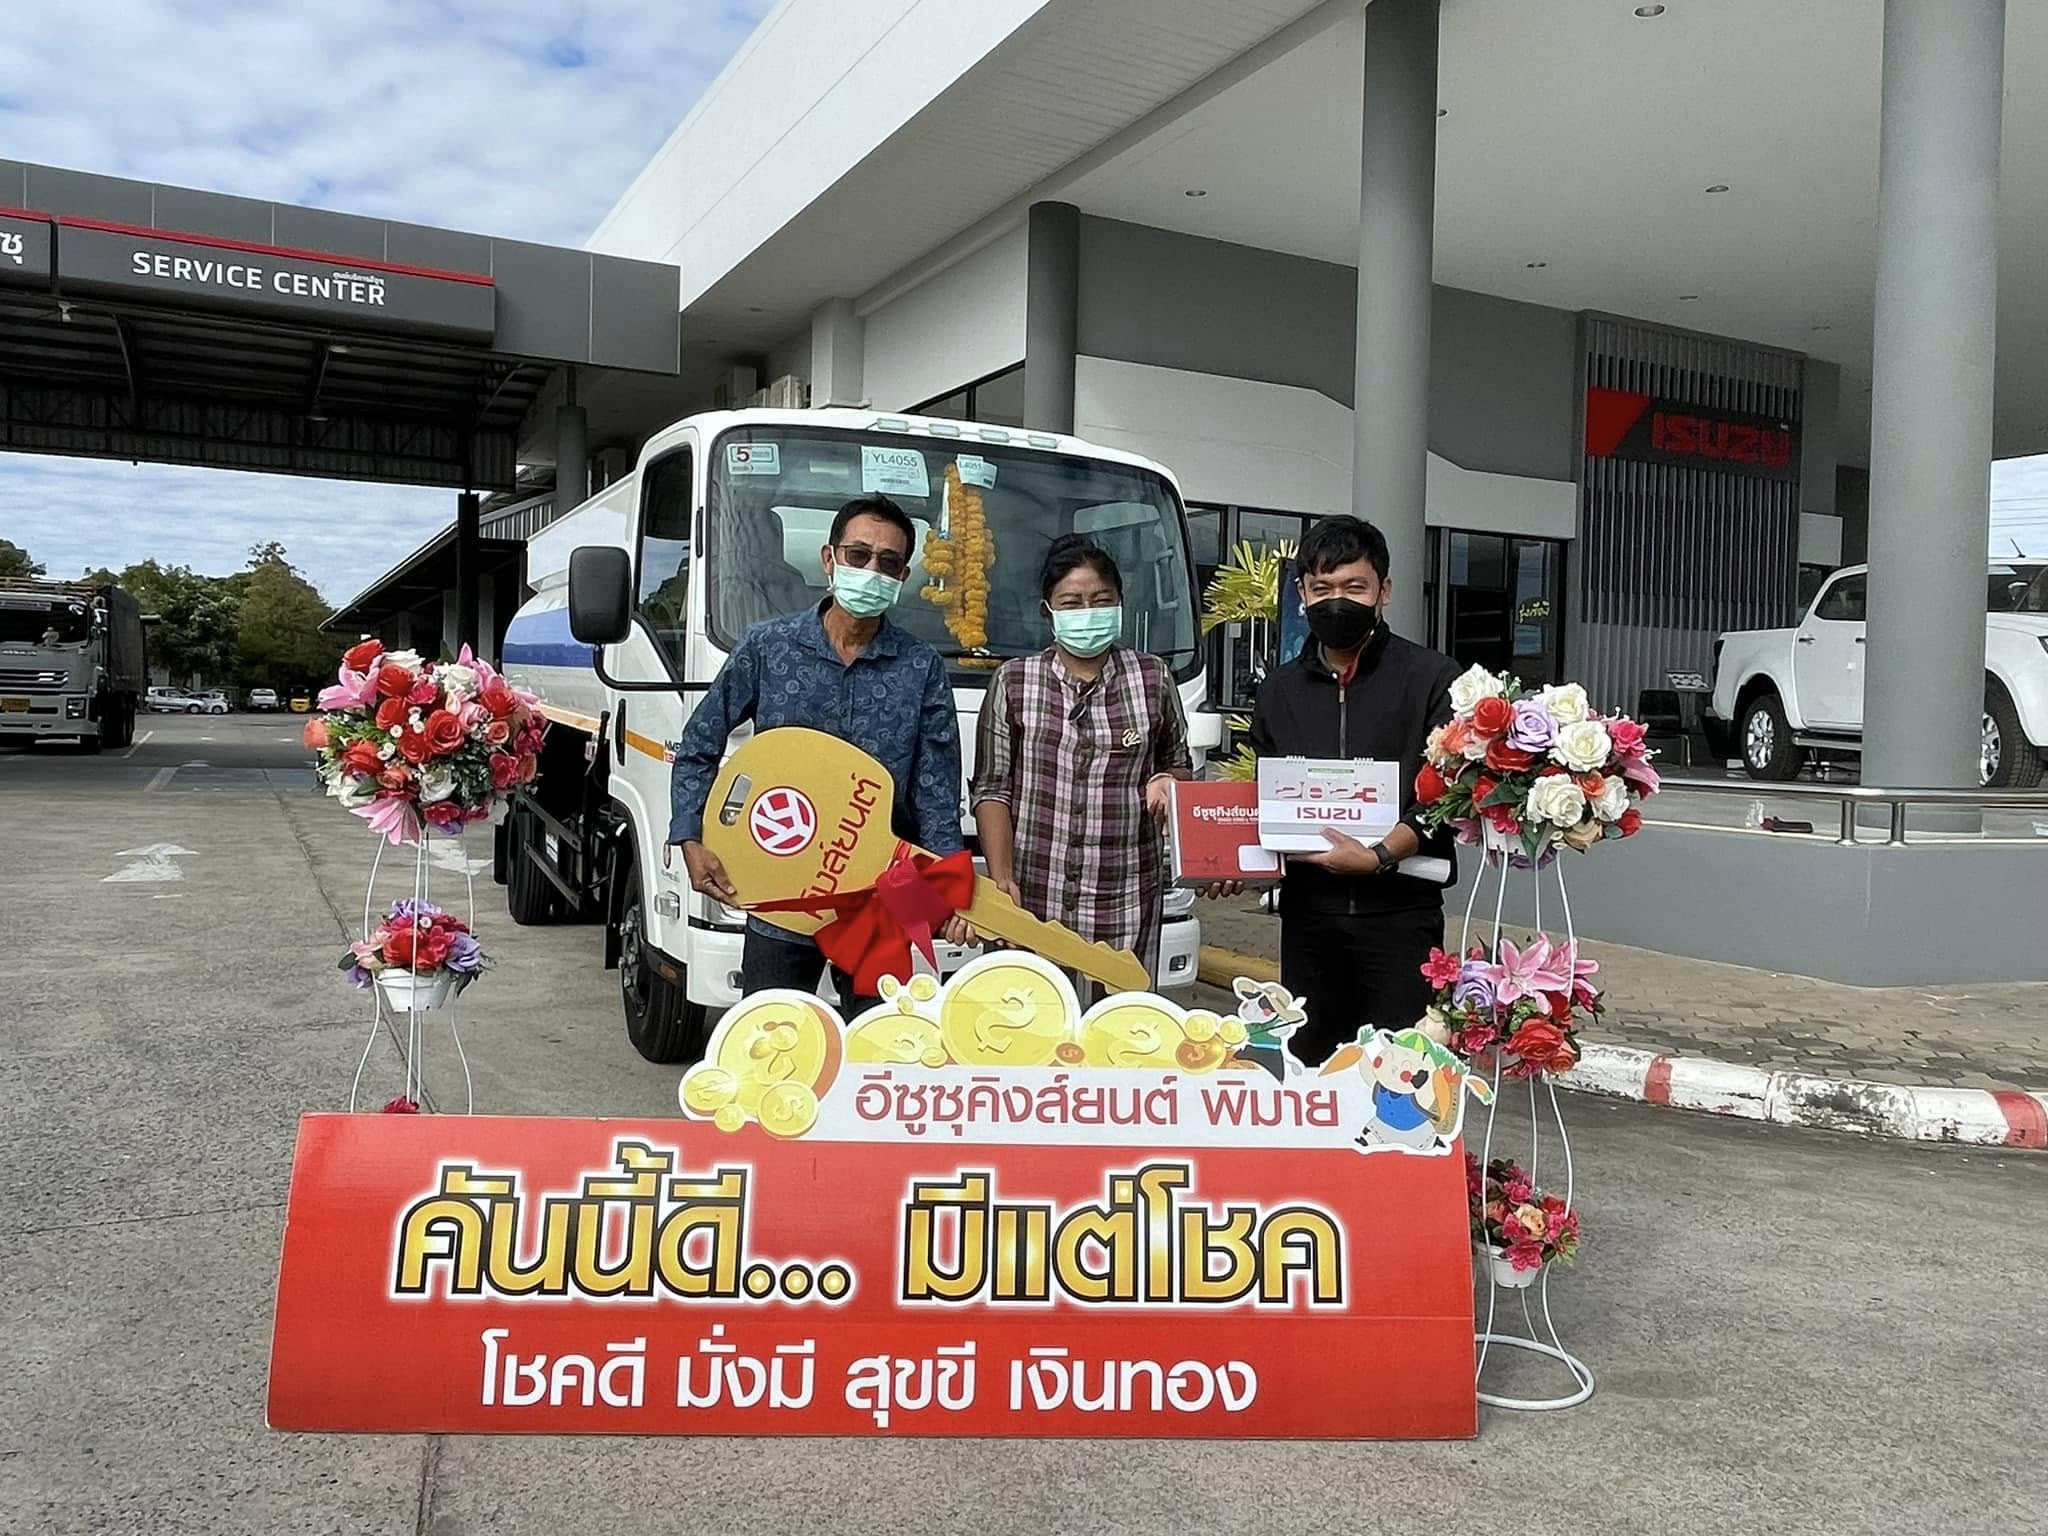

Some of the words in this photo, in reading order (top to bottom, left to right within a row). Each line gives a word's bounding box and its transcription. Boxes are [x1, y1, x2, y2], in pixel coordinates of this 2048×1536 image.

[132, 251, 263, 290] SERVICE
[273, 271, 385, 306] CENTER
[736, 446, 750, 463] 5
[872, 453, 918, 468] YL4055
[1652, 411, 1790, 467] ISUZU
[1296, 806, 1362, 821] ISUZU
[854, 1070, 1178, 1136] อีซูซุคิงส์ยนต์
[1200, 1080, 1340, 1127] พิมาย
[902, 1163, 1343, 1304] มีแต่โชค
[481, 1327, 647, 1408] โชคดี
[676, 1324, 816, 1409] มั่งมี
[845, 1341, 978, 1428] สุขขี
[1010, 1347, 1259, 1412] เงินทอง
